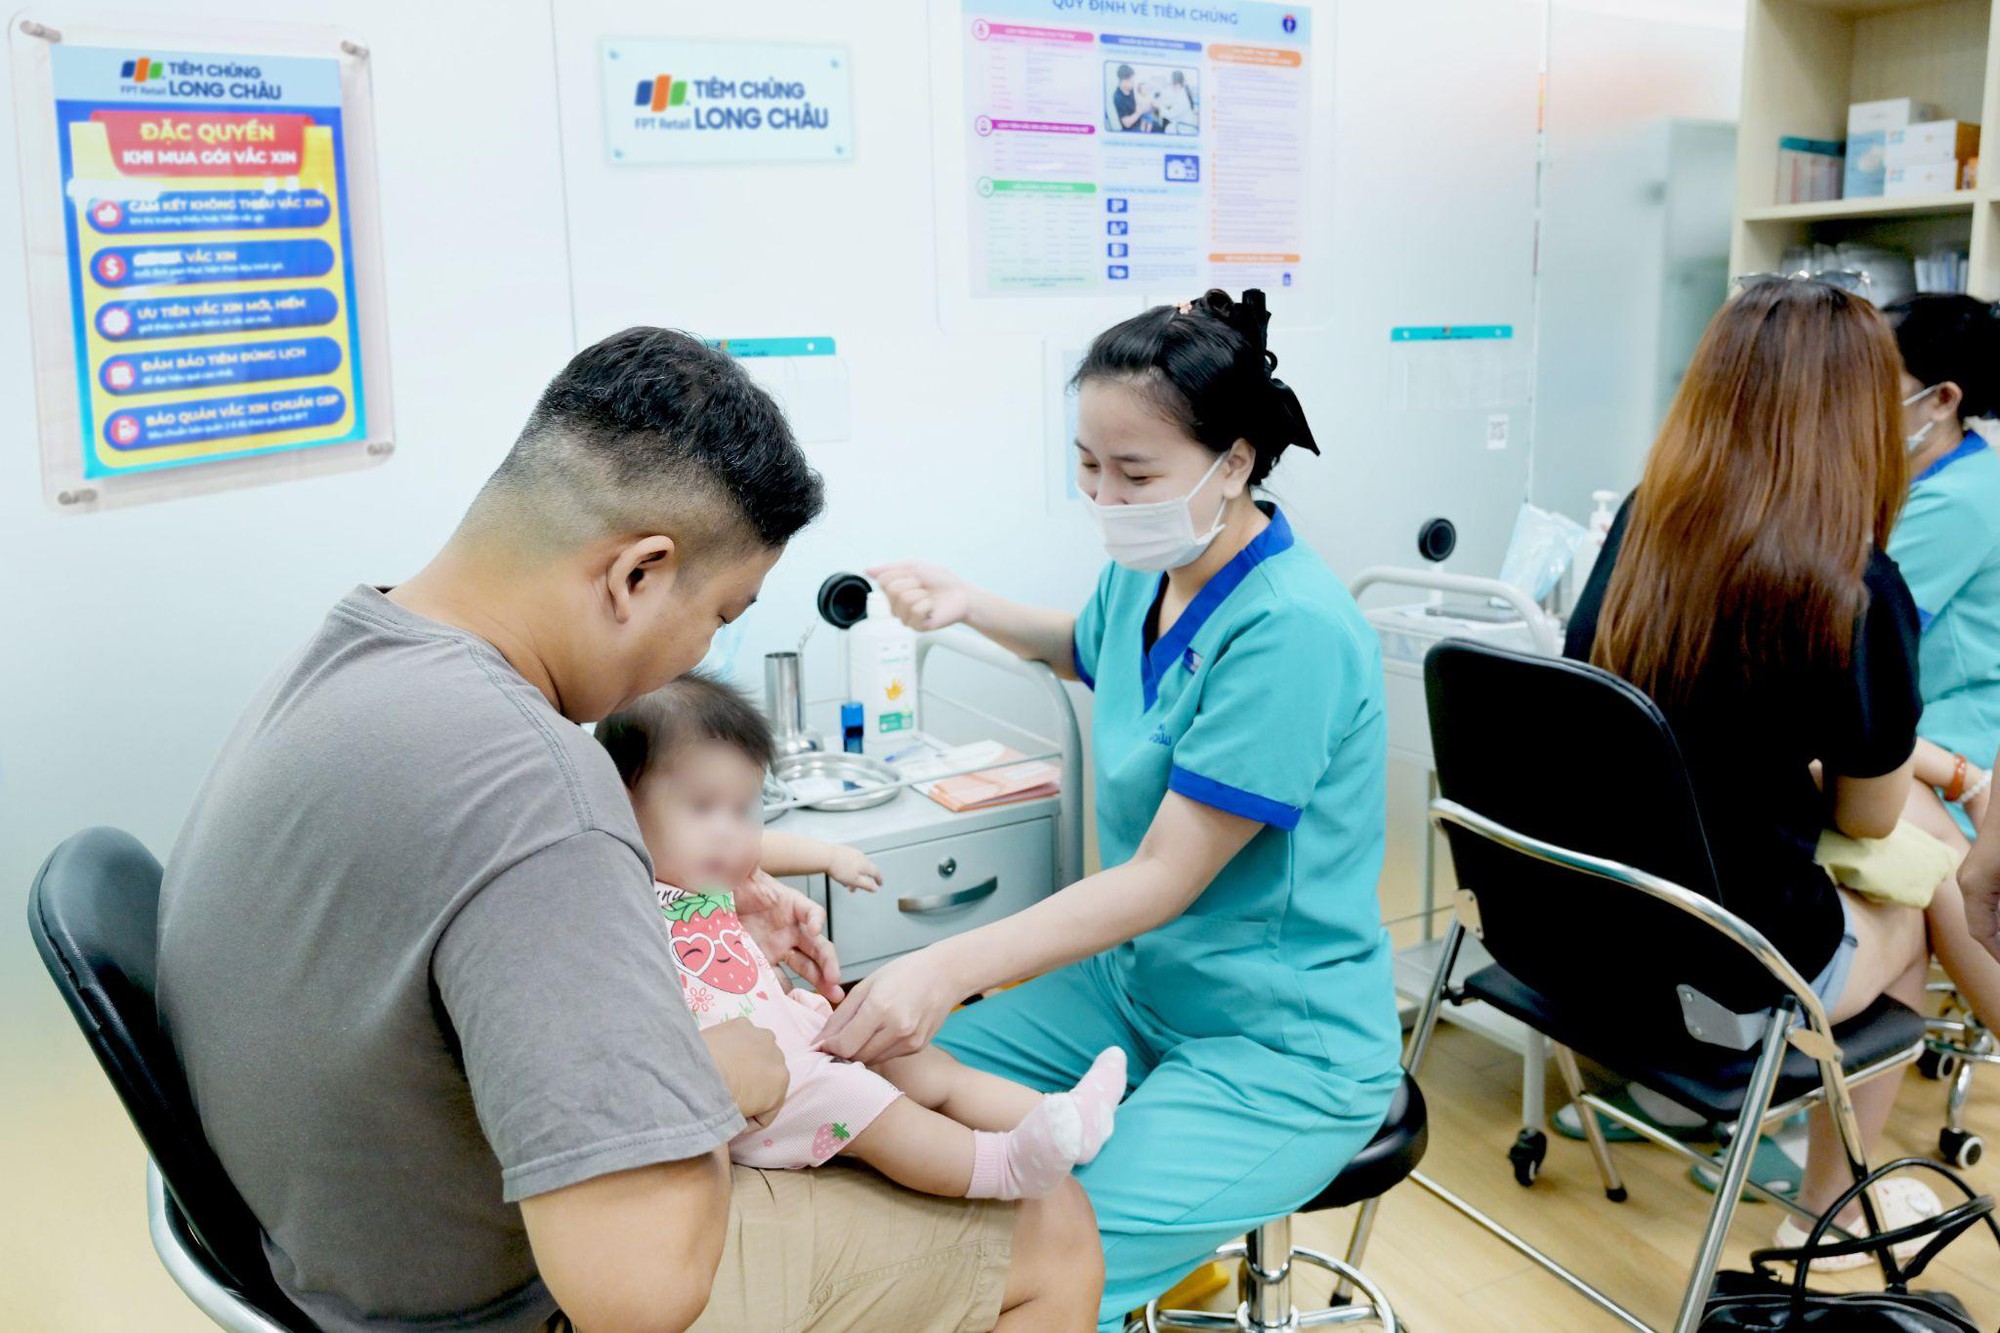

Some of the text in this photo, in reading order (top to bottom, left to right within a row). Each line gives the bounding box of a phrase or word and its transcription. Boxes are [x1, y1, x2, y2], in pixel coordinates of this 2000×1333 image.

[168, 60, 203, 76] TIÊM
[169, 80, 282, 100] LONG CHÂU
[693, 75, 736, 99] TIÊM
[635, 117, 691, 130] FPT Retail
[694, 102, 829, 130] LONG CHÂU
[140, 118, 192, 145] ĐẶC
[123, 147, 298, 165] KHI MUA GÓI VẮC XIN
[304, 197, 324, 208] XIN
[215, 251, 237, 262] XIN
[222, 302, 244, 313] XIN
[249, 403, 269, 415] XIN
